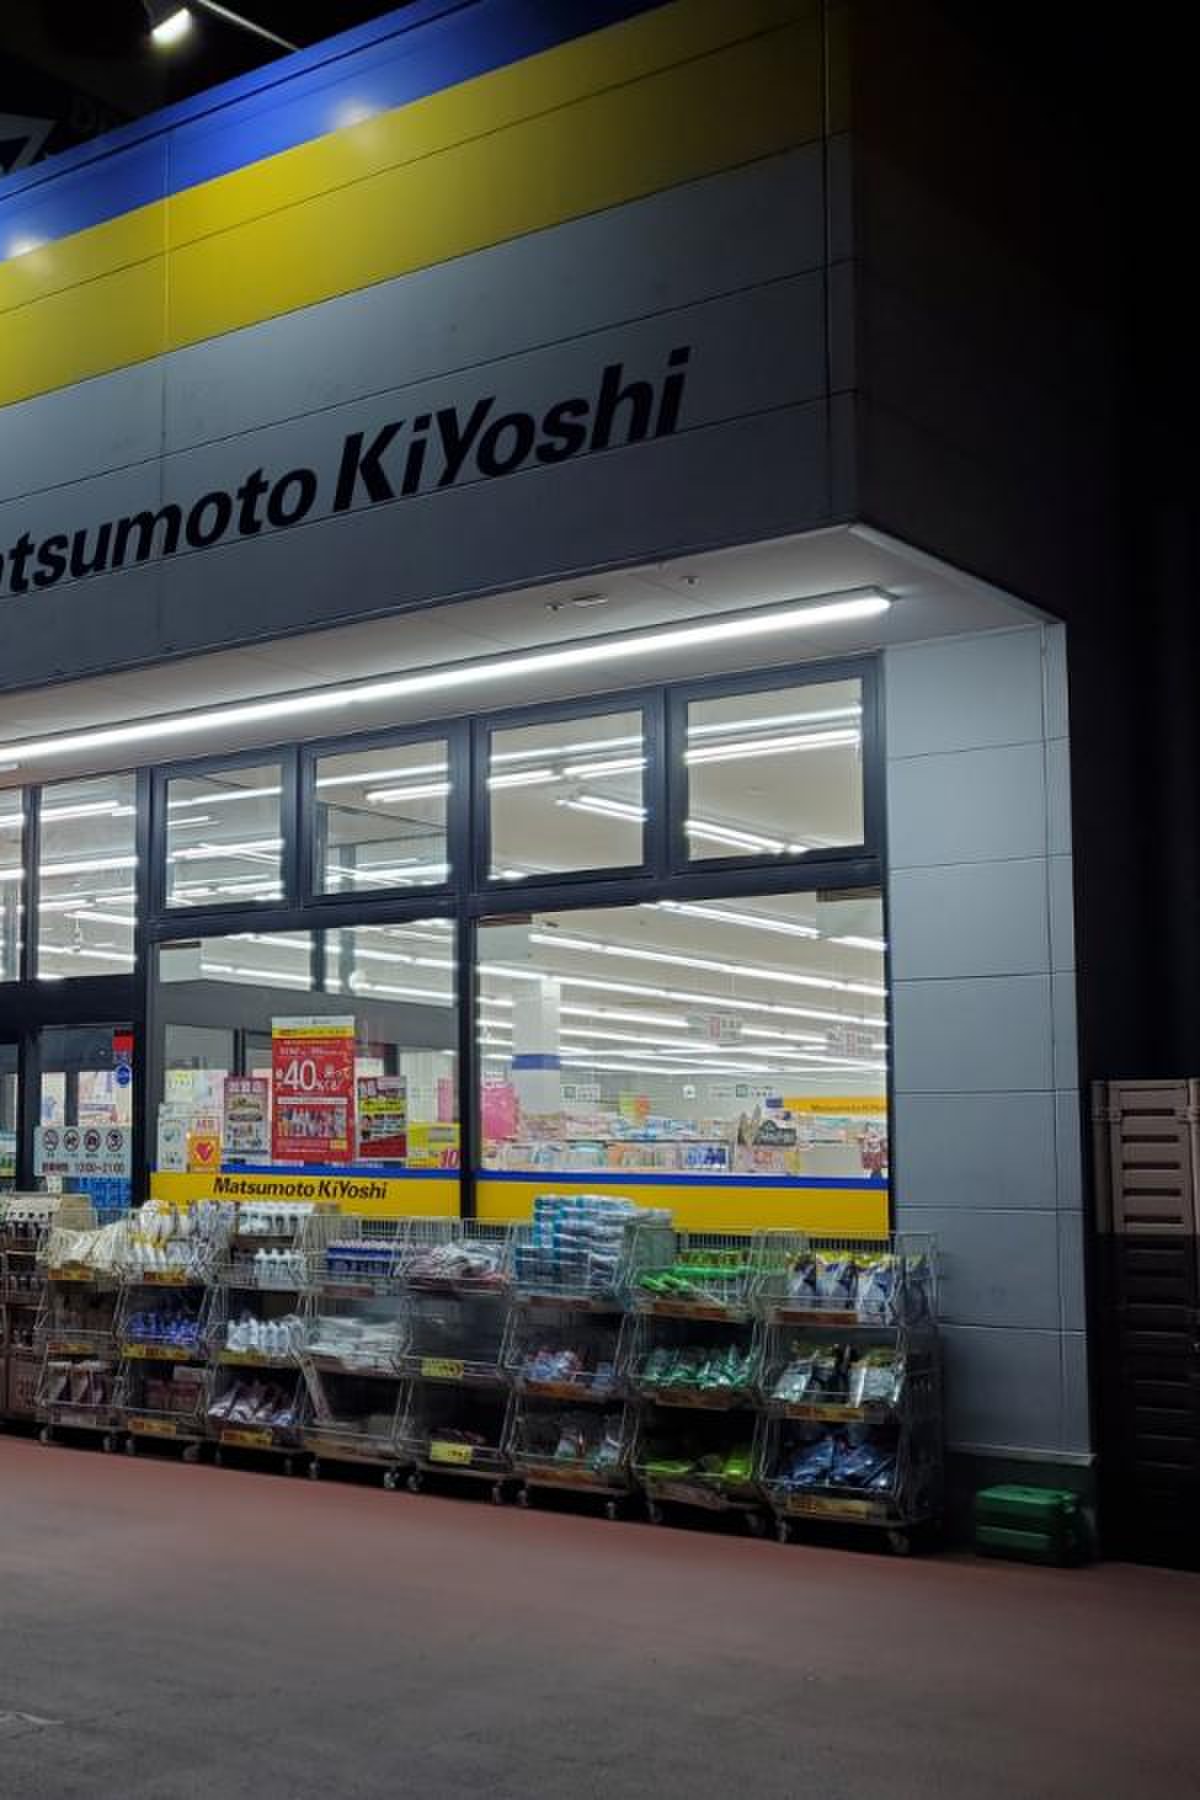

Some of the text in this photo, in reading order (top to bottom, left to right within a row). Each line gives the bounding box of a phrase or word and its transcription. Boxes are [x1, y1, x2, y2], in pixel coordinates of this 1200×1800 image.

[333, 347, 691, 511] KiYoshi
[285, 1057, 317, 1091] 40
[213, 1176, 387, 1200] Matsumoto KiYoshi
